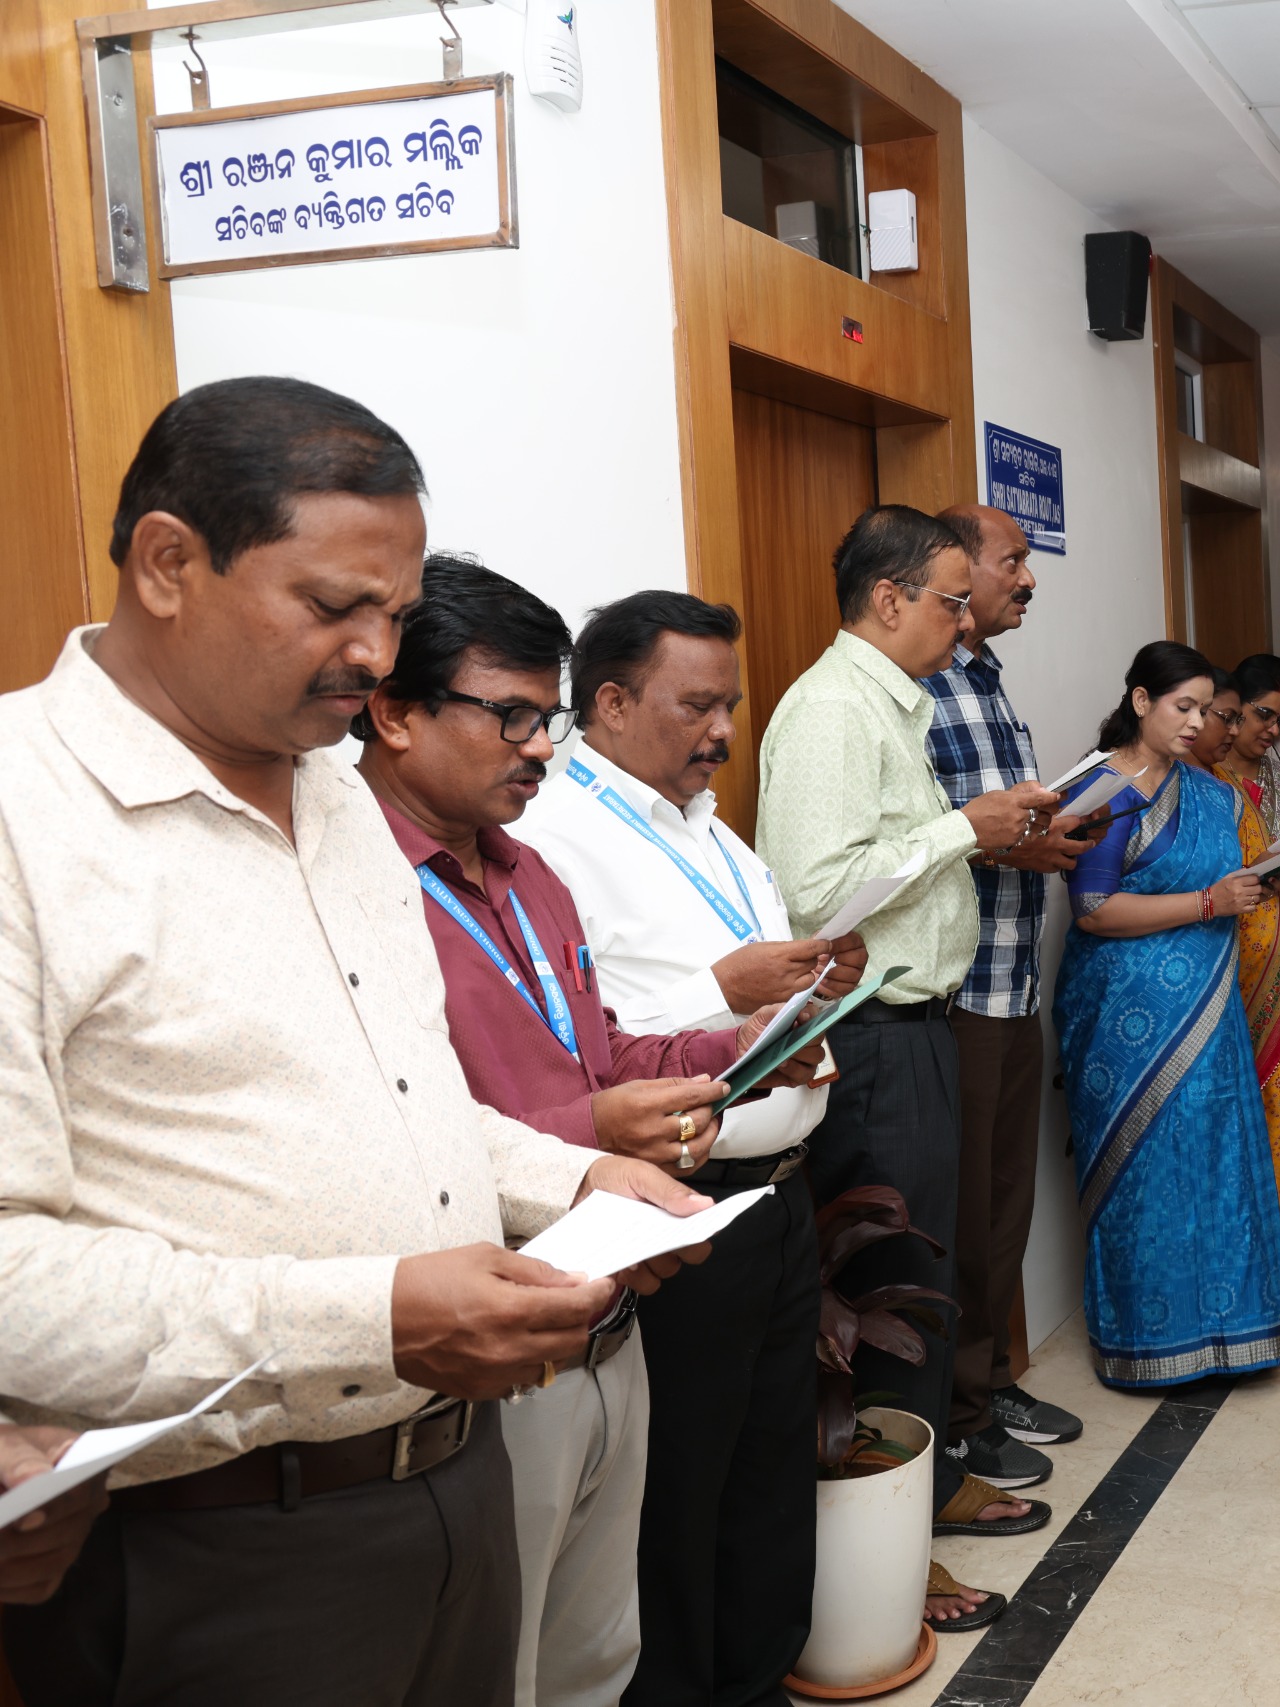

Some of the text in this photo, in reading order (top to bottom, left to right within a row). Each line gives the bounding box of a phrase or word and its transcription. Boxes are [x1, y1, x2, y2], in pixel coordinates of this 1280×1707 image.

[179, 159, 213, 197] ଶ୍ରୀ
[221, 149, 295, 188] ରଞ୍ଜନ
[306, 136, 392, 183] କୁମାର
[215, 205, 287, 242] ସଚିବଙ୍କ
[395, 181, 455, 220] ସଚିବ
[1013, 516, 1046, 537] ECRETARY
[602, 794, 633, 820] SECRETARIAT
[429, 880, 479, 933] LEGISLATIVE
[479, 931, 505, 965] ODISHA
[524, 924, 541, 956] ODISHA
